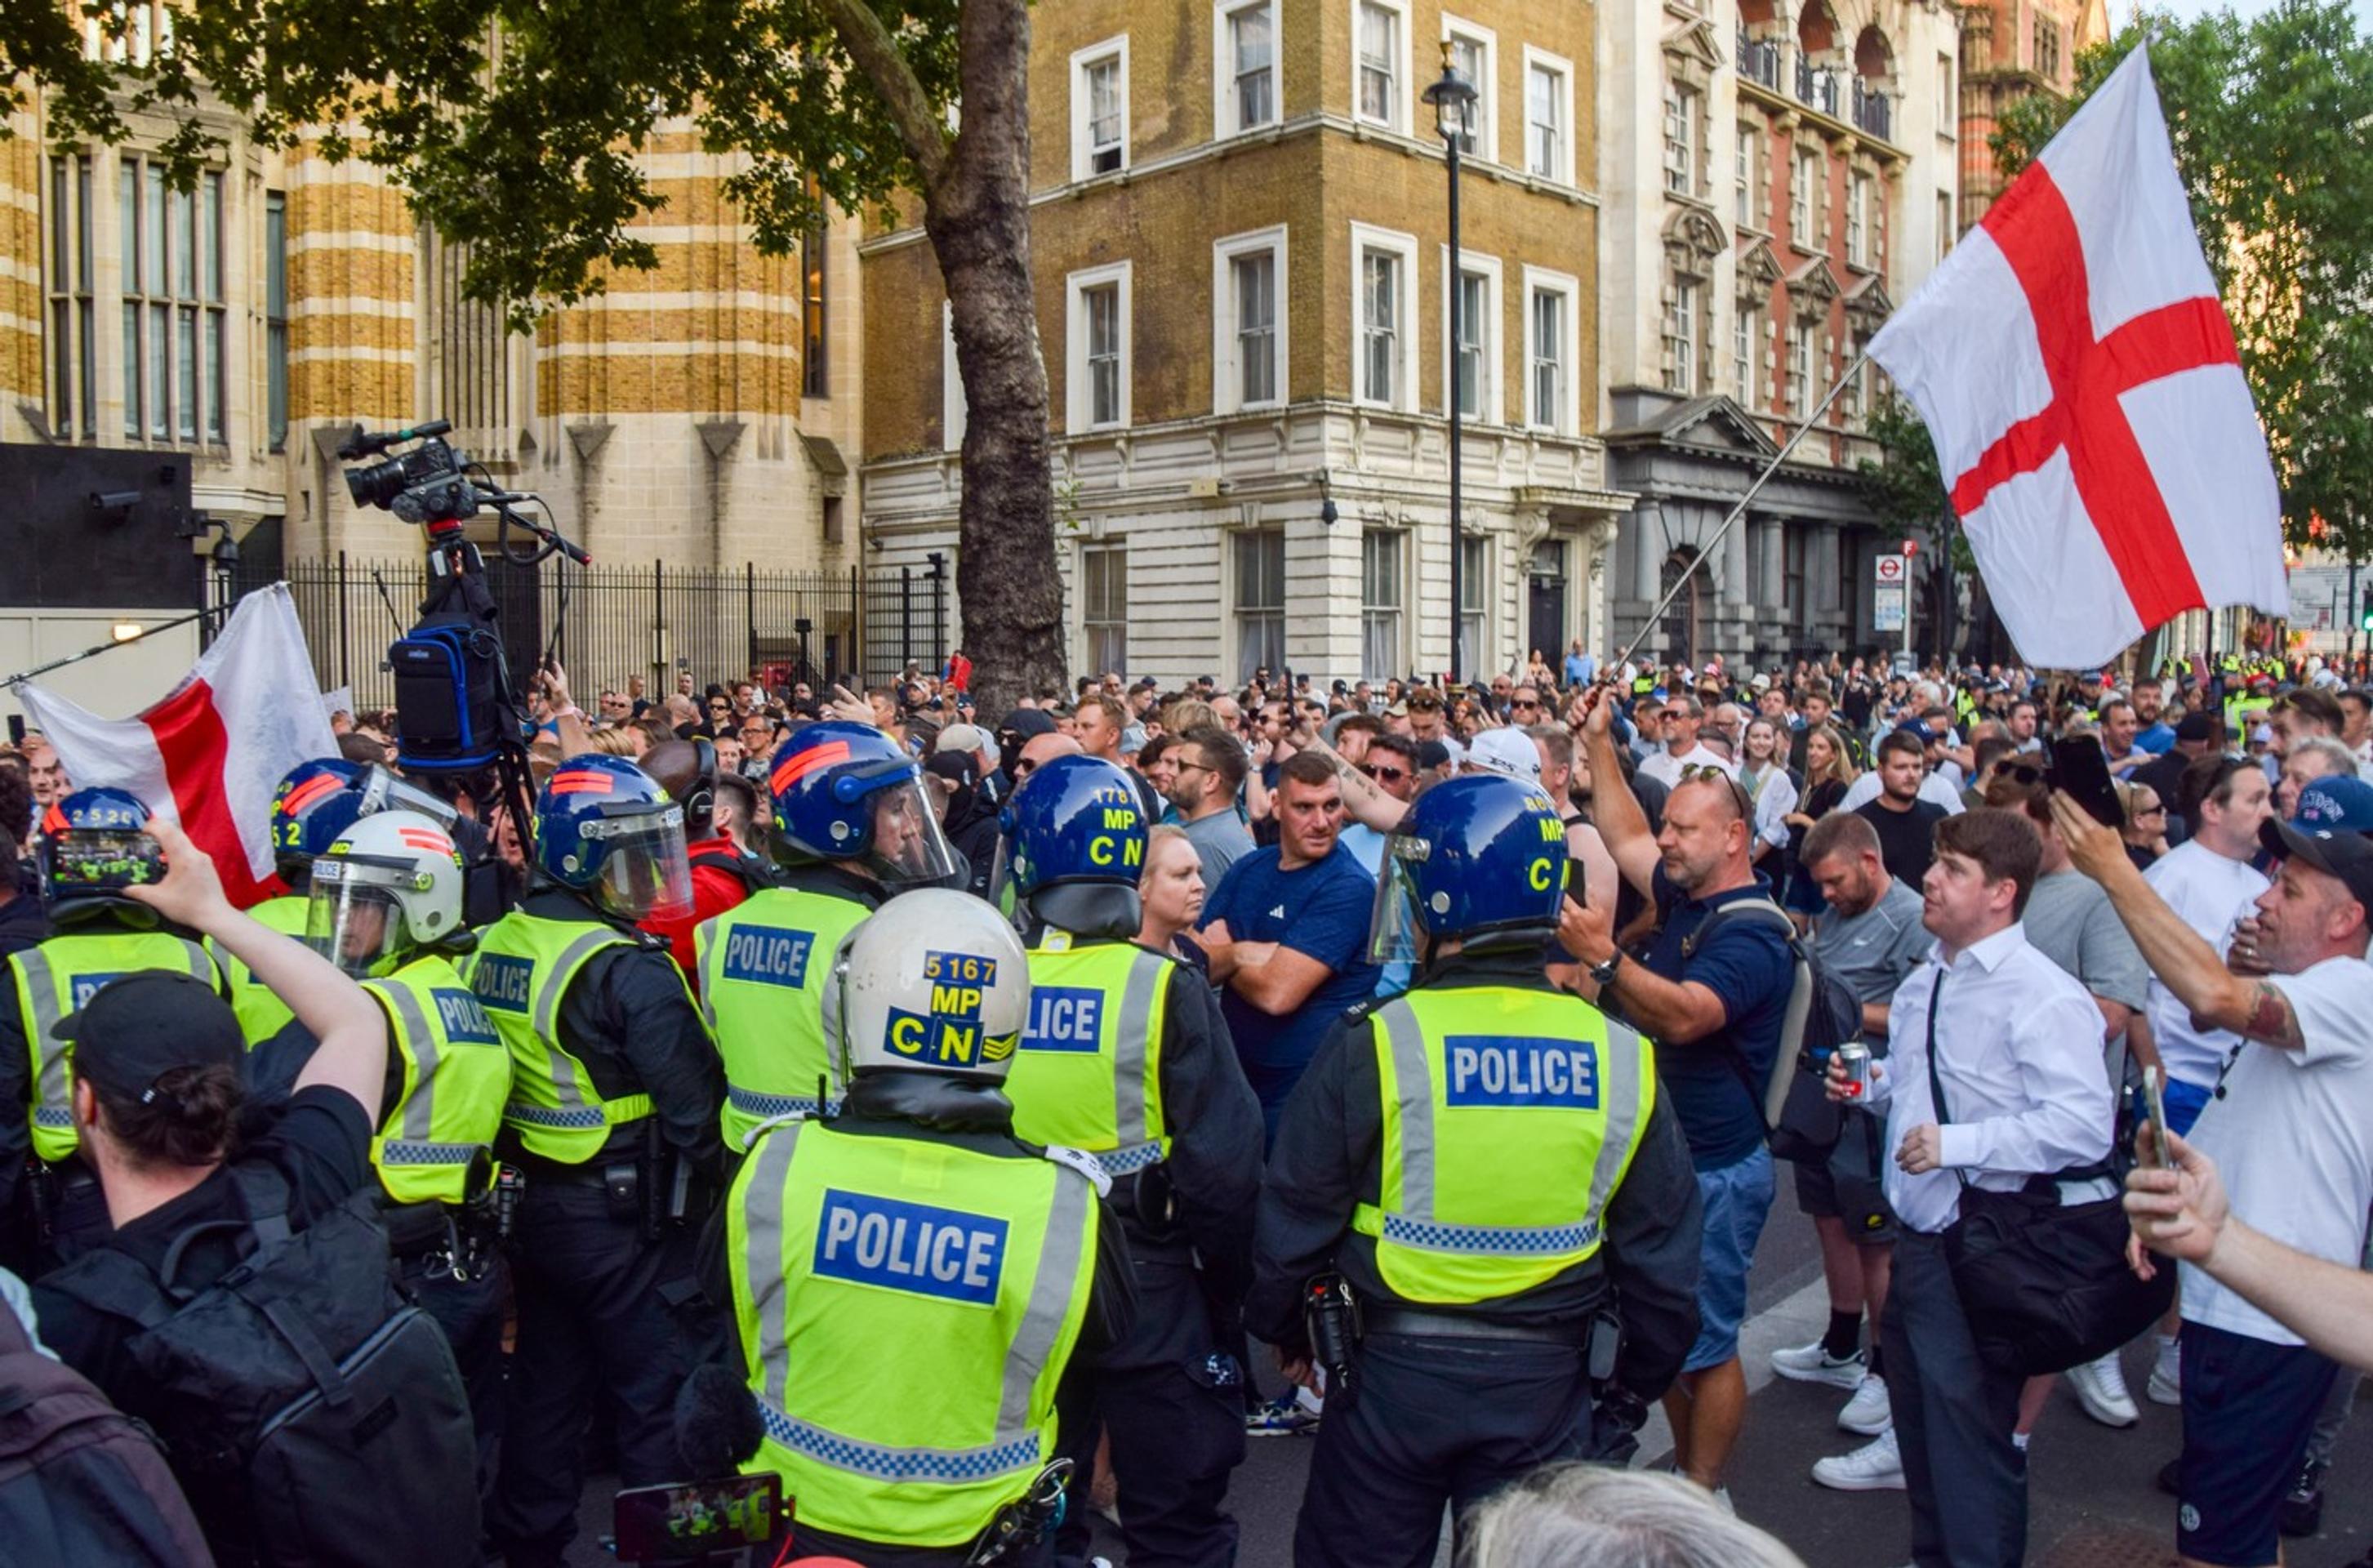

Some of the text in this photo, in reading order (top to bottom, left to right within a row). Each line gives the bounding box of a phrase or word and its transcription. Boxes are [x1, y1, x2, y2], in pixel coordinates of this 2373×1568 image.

[1104, 808, 1136, 830] MP
[1539, 817, 1565, 842] MP
[726, 933, 807, 978] POLICE
[932, 985, 980, 1015] MP
[1022, 998, 1096, 1040] LICE
[1454, 1047, 1592, 1096] POLICE
[824, 1206, 996, 1288] POLICE
